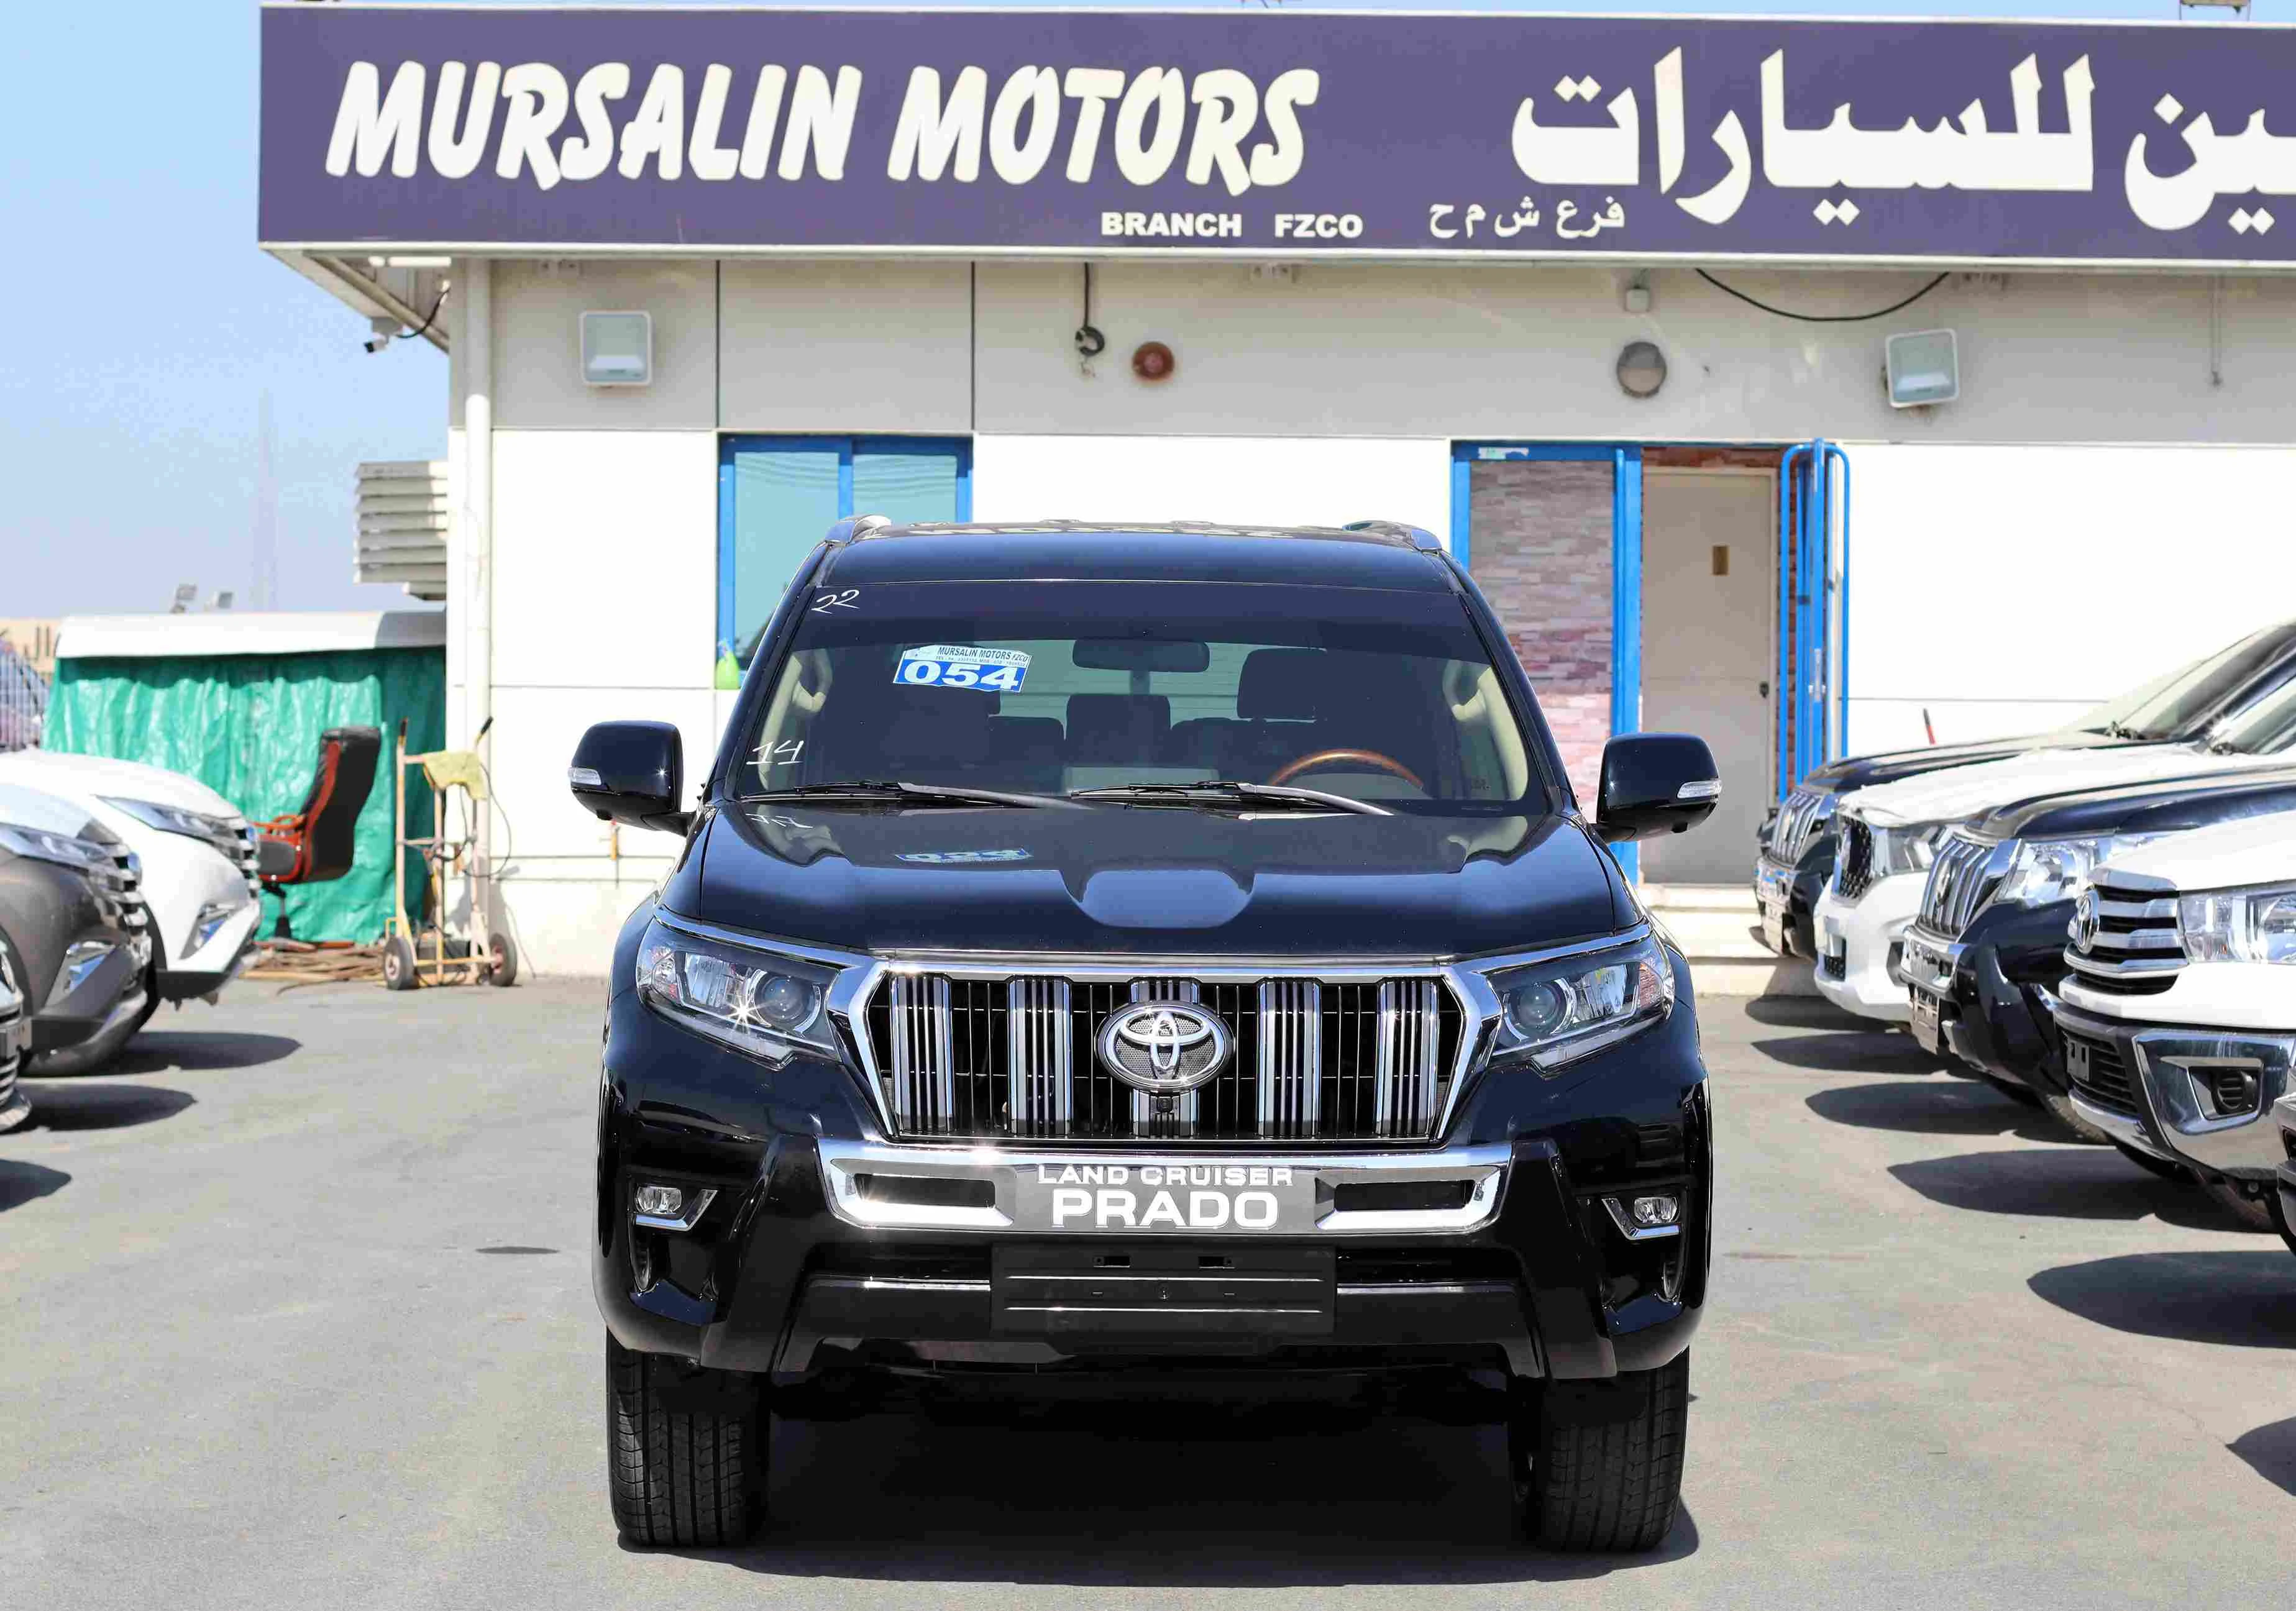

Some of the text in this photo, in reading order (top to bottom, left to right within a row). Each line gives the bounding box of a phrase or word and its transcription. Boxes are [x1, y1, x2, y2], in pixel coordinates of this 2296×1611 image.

[325, 61, 1319, 196] MURSALIN MOTORS
[1512, 47, 2095, 226] للسيارات
[1101, 212, 1363, 238] BRANCH FZCO
[1556, 196, 1626, 239] فرع
[811, 589, 861, 614] 22
[937, 646, 977, 657] MURSALIN
[978, 649, 1011, 660] MOTORS
[904, 660, 1019, 690] 054
[746, 740, 805, 765] 14
[1038, 1164, 1293, 1187] LAND CRUISER
[1051, 1188, 1279, 1230] PRADO
